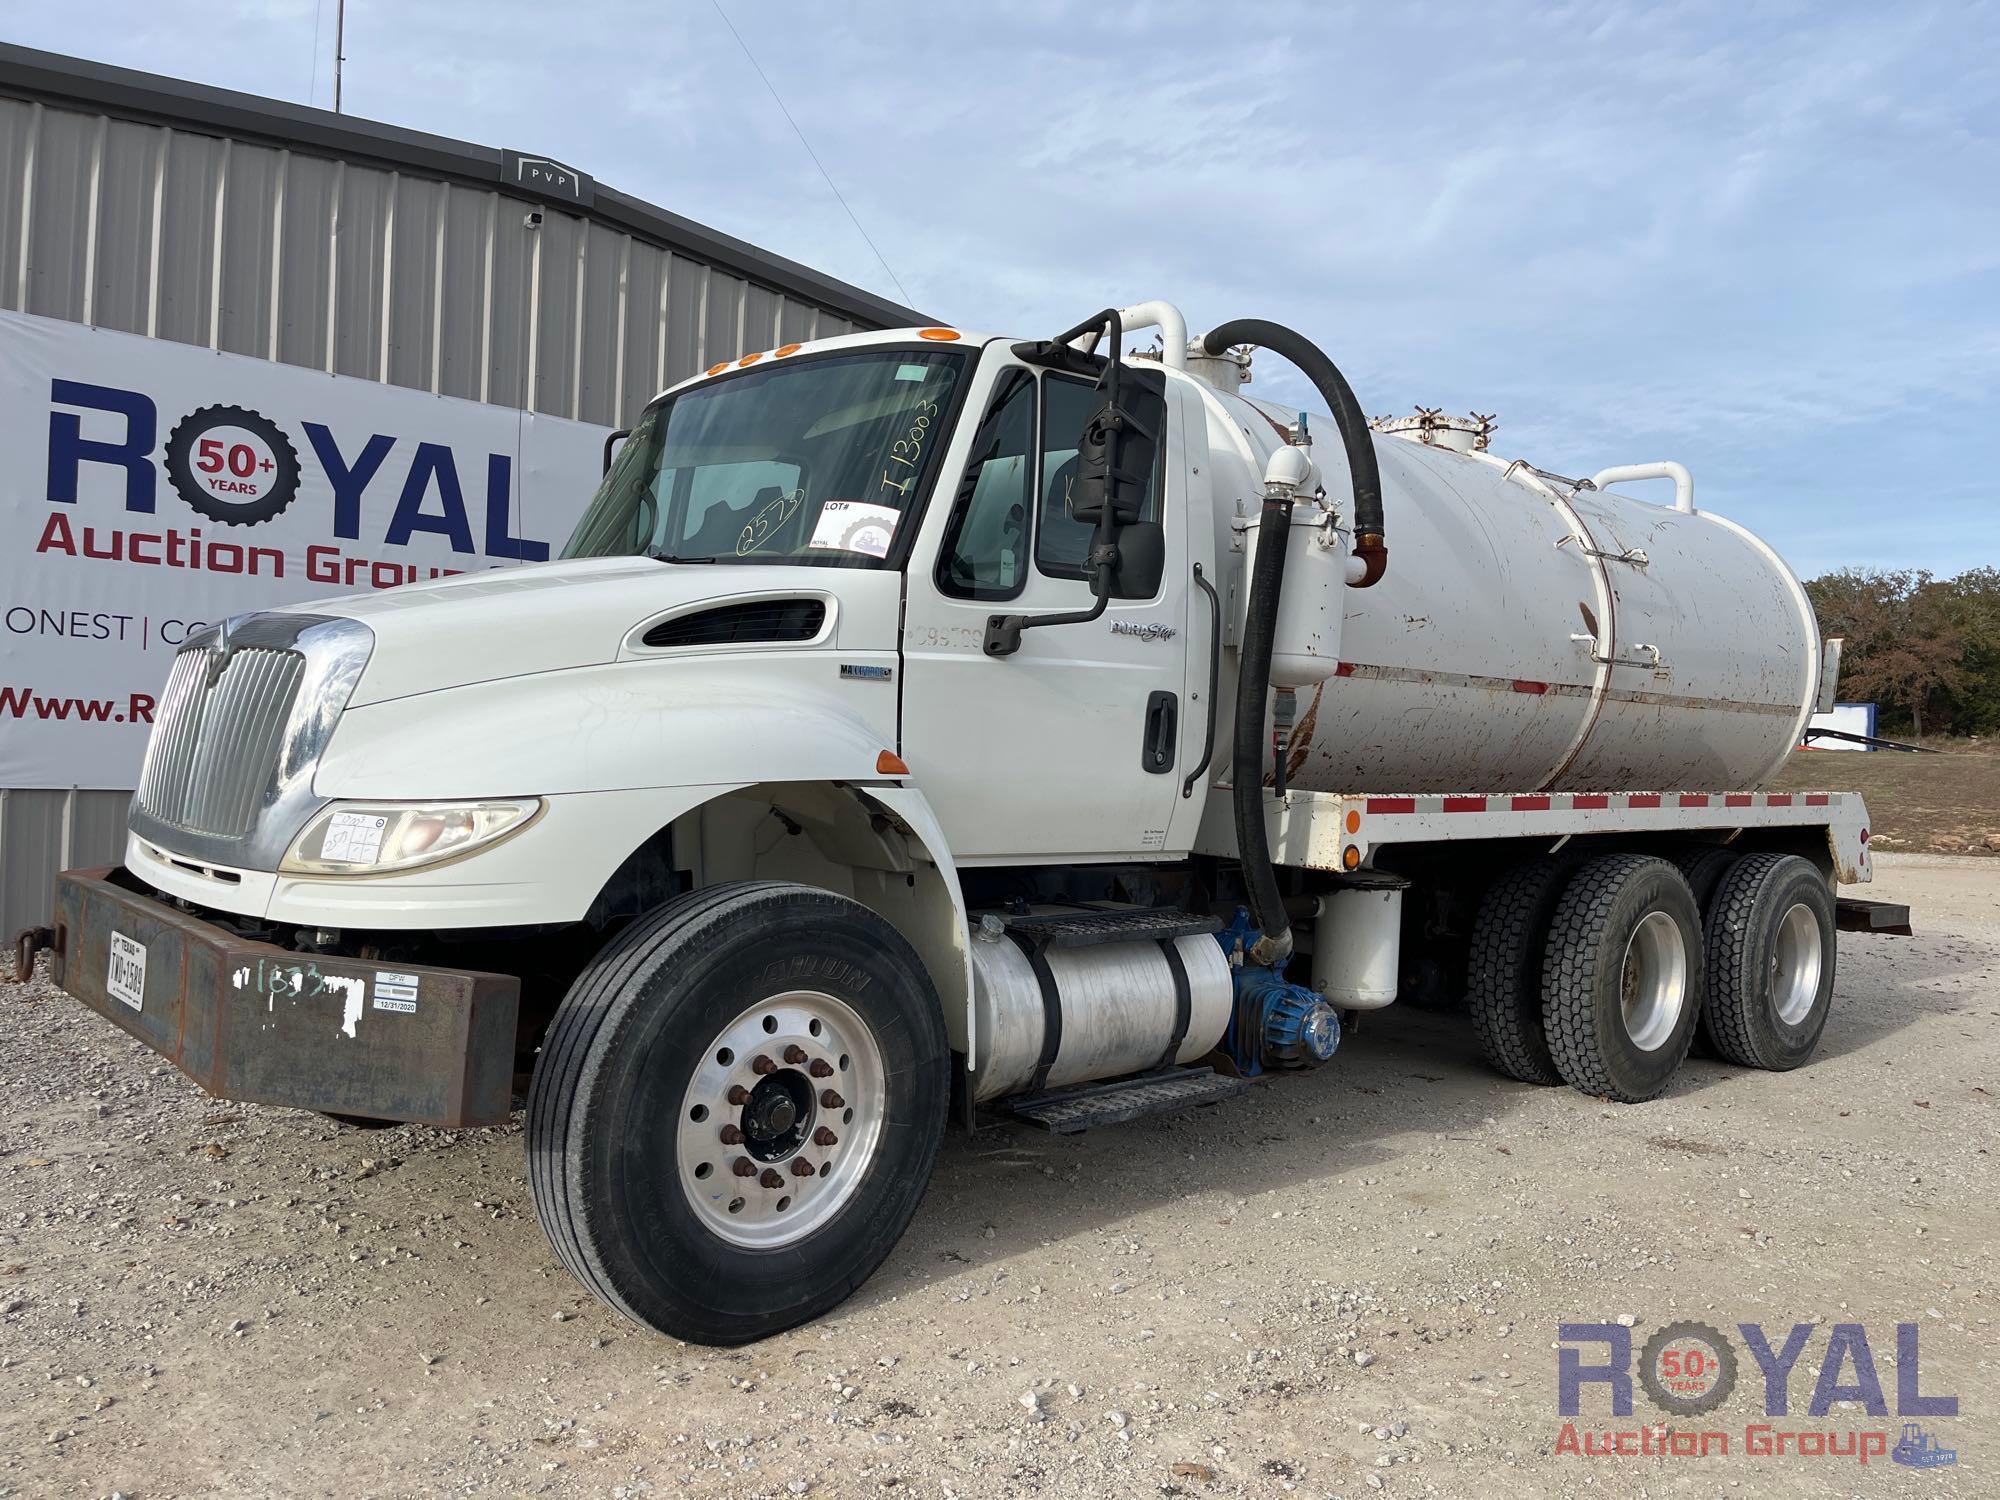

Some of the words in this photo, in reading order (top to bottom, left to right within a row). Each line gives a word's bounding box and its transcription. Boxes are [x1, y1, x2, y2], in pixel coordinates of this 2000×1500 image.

[196, 438, 275, 478] 50+
[208, 478, 257, 495] YEARS
[824, 502, 850, 511] LOT#
[36, 511, 284, 579] Auction
[306, 544, 467, 589] Grou
[121, 938, 135, 956] TEXAS
[380, 1000, 415, 1012] 12/31/2020
